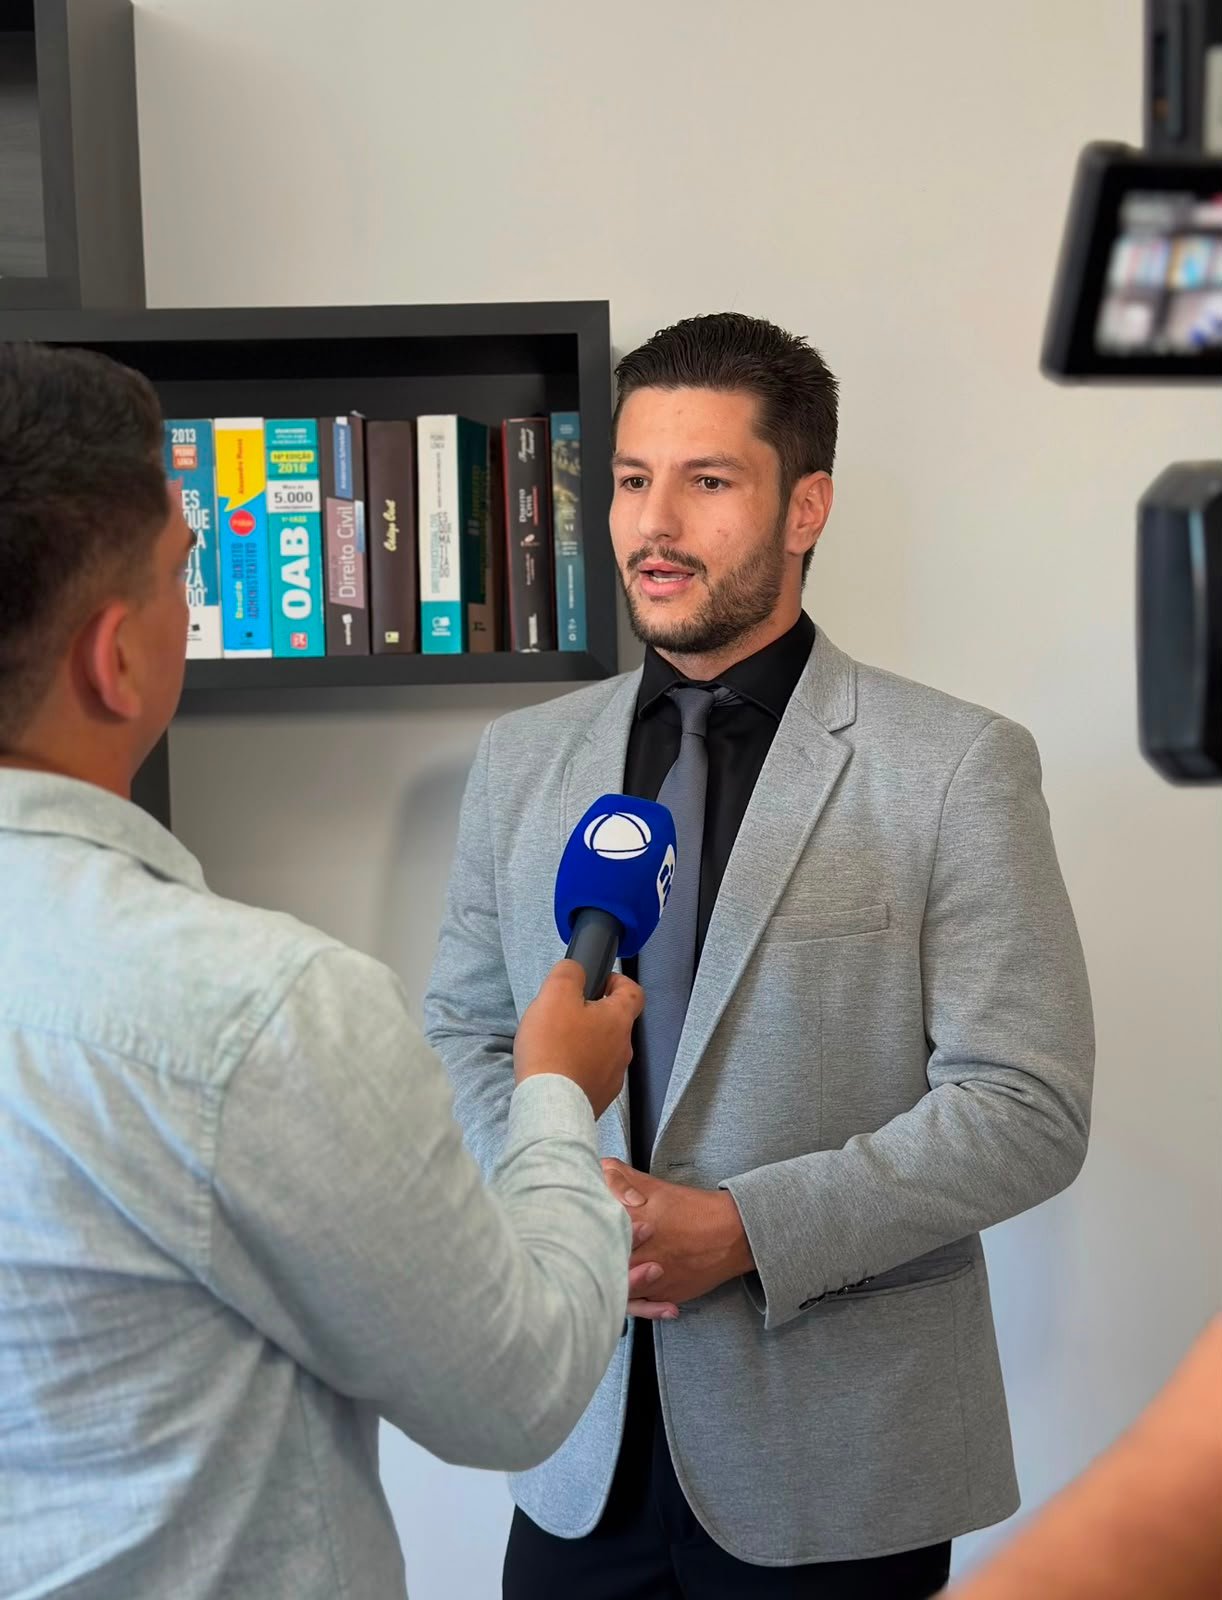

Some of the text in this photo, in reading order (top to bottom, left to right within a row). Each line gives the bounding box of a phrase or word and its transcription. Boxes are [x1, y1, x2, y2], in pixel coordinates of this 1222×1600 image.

[171, 428, 196, 443] 2013
[274, 491, 313, 504] 5.000
[280, 526, 312, 619] OAB
[336, 506, 356, 598] Direito Civil
